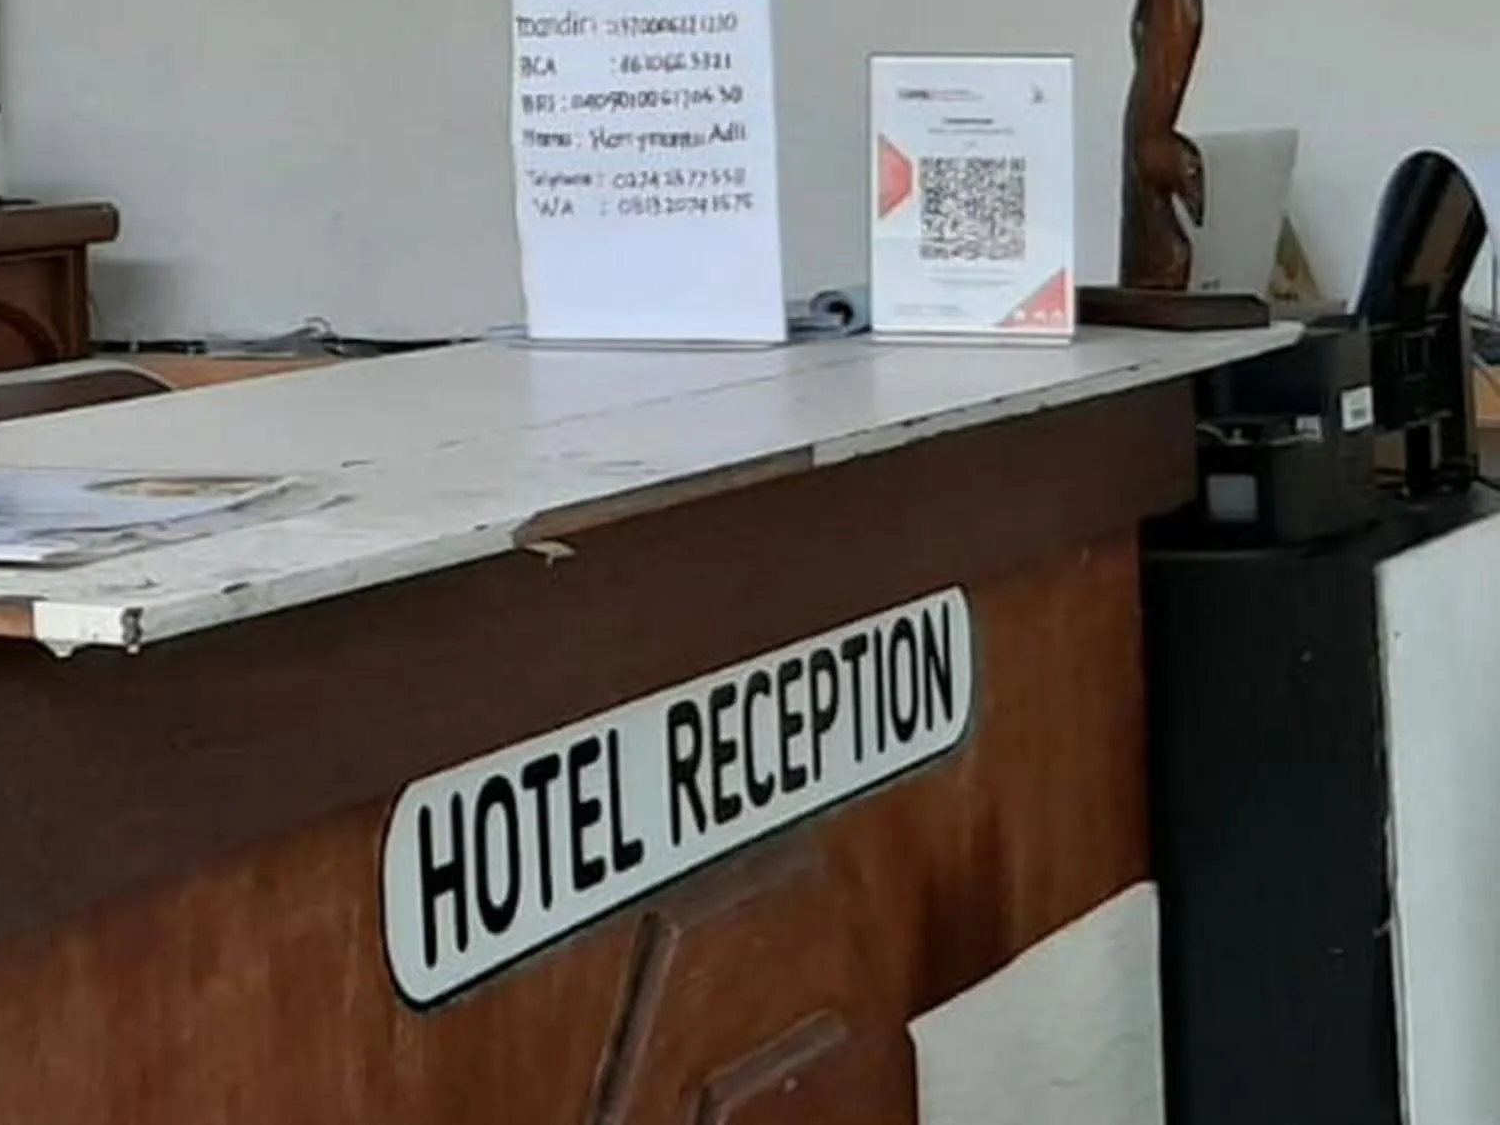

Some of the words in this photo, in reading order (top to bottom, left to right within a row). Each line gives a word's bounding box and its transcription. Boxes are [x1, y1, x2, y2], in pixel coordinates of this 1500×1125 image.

[520, 56, 557, 77] BCA
[418, 729, 643, 969] HOTEL
[667, 601, 954, 847] RECEPTION
